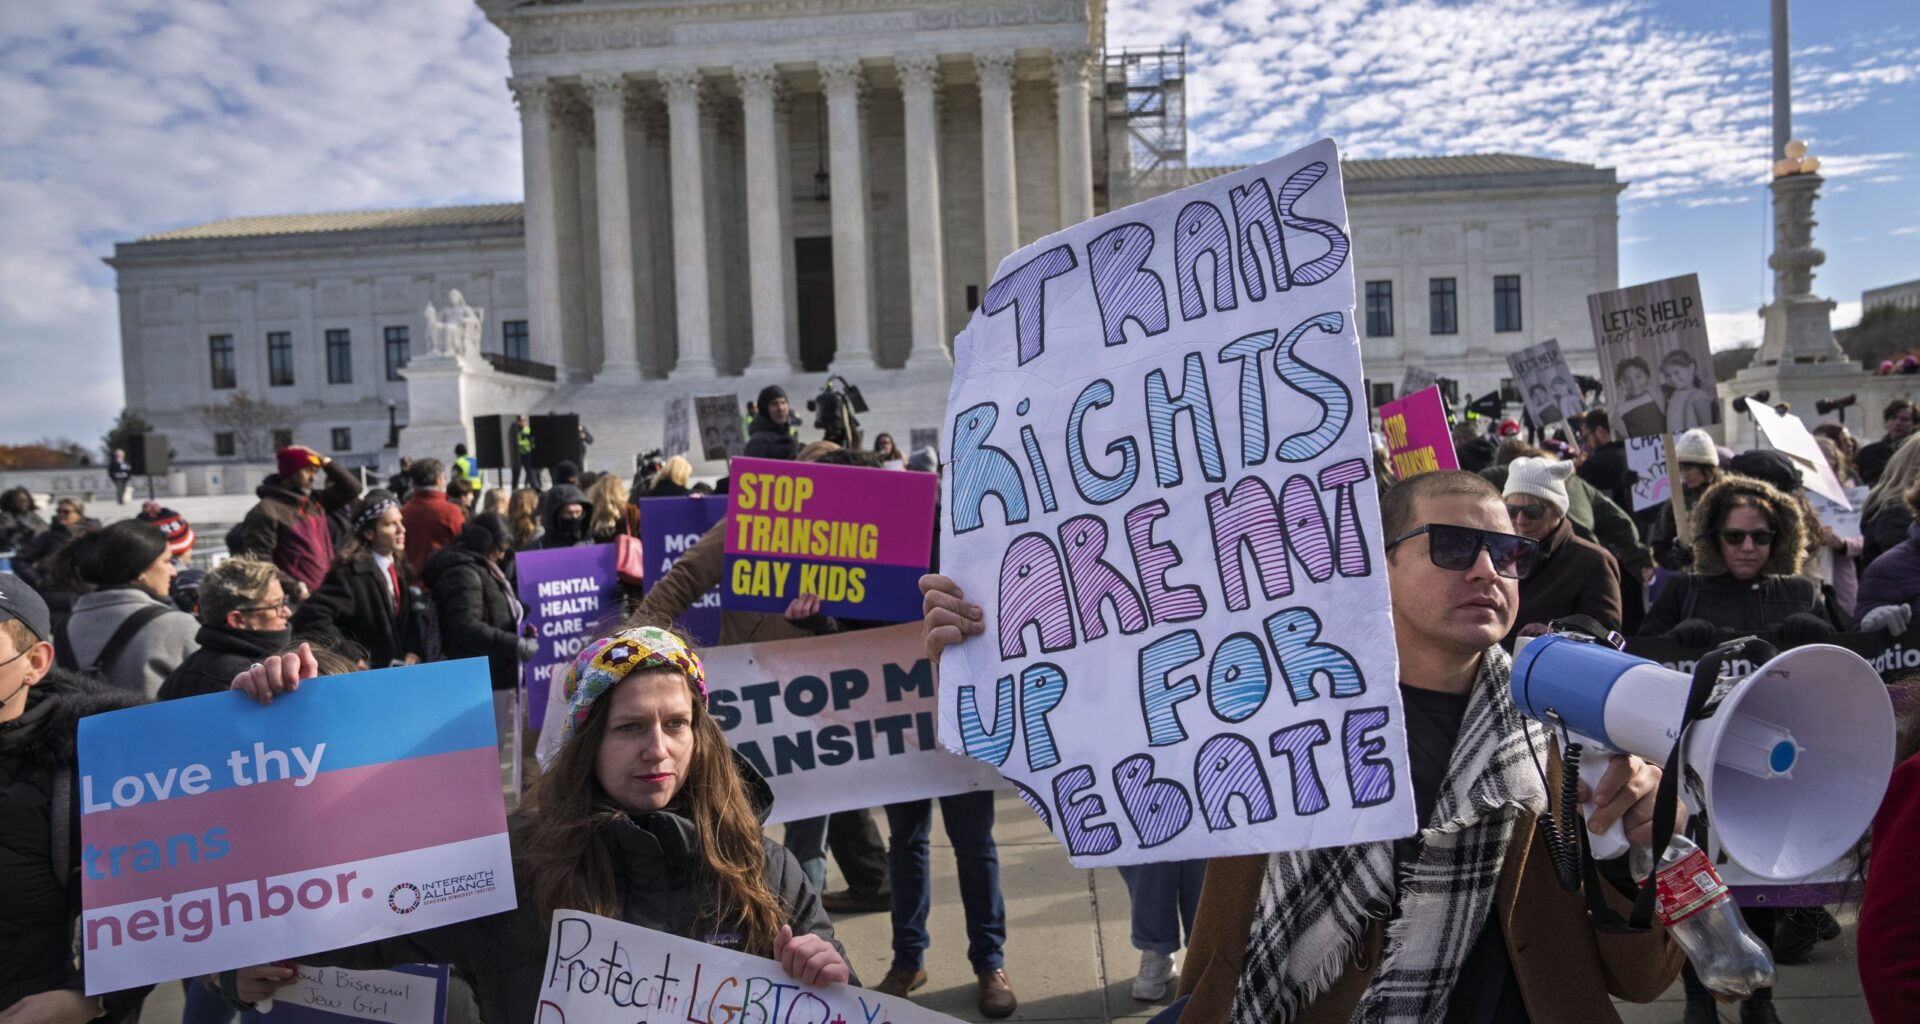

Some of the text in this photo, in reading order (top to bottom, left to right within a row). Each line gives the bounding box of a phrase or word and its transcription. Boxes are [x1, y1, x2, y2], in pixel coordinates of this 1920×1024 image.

[981, 161, 1349, 366] TRANS
[1601, 317, 1700, 346] not harm
[1602, 297, 1693, 333] LET'S HELP
[1384, 413, 1408, 450] STOP
[738, 472, 814, 513] STOP
[736, 514, 879, 560] TRANSING
[731, 559, 867, 603] GAY KIDS
[999, 458, 1371, 661] ARE NOT
[538, 577, 600, 598] MENTAL
[540, 597, 599, 618] HEALTH
[542, 618, 583, 637] CARE
[708, 669, 870, 731] STOP
[958, 607, 1366, 772] UP FOR
[736, 712, 936, 778] ANSITI
[82, 742, 326, 814] Love thy
[82, 827, 231, 880] trans
[422, 869, 494, 891] INTERFAITH
[423, 877, 495, 900] ALLIANCE
[87, 871, 374, 950] neighbor.
[549, 918, 680, 1009] Protect
[353, 996, 388, 1016] Girl
